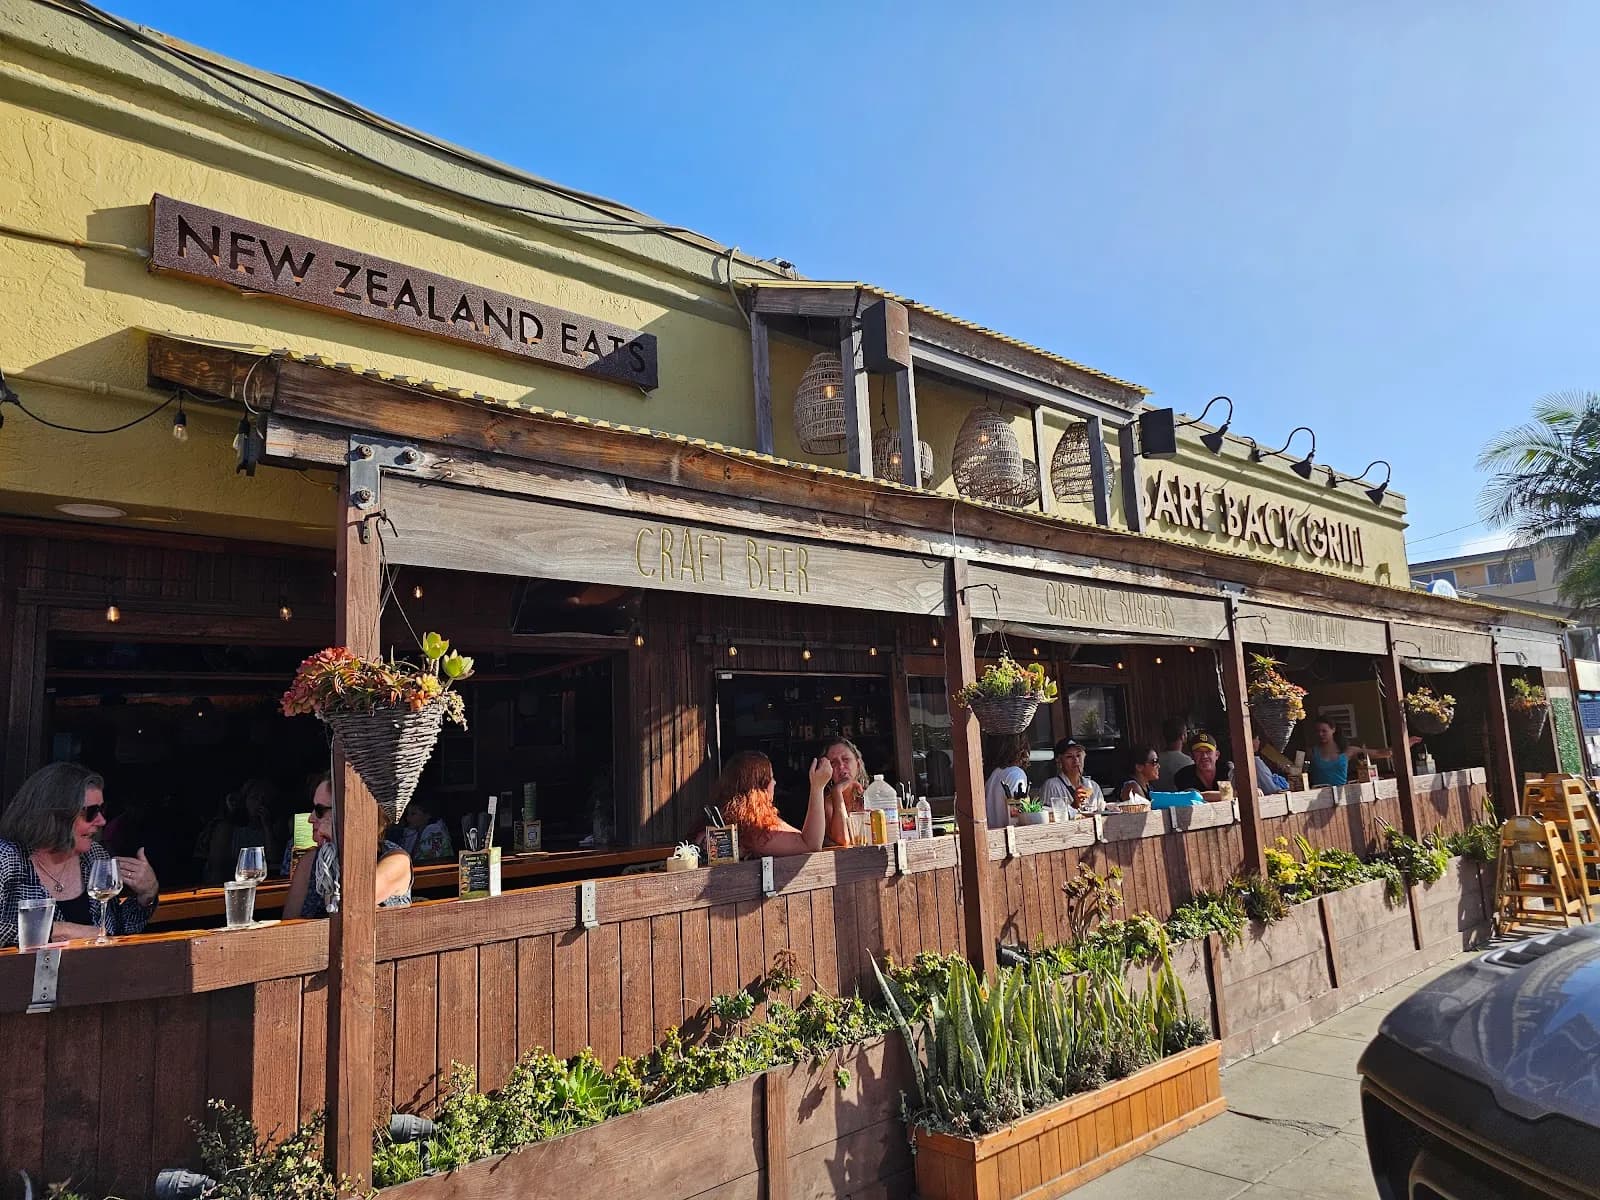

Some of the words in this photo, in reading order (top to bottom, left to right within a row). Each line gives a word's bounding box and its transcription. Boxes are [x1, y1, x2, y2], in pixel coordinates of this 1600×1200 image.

[177, 214, 315, 287] NEW
[333, 261, 544, 346] ZEALAND
[561, 321, 646, 374] EATS
[1221, 489, 1300, 551] BACK
[635, 527, 727, 585] CRAFT
[745, 538, 809, 596] BEER
[1045, 582, 1113, 623] ORGANIC
[1118, 591, 1176, 630] BURGERS
